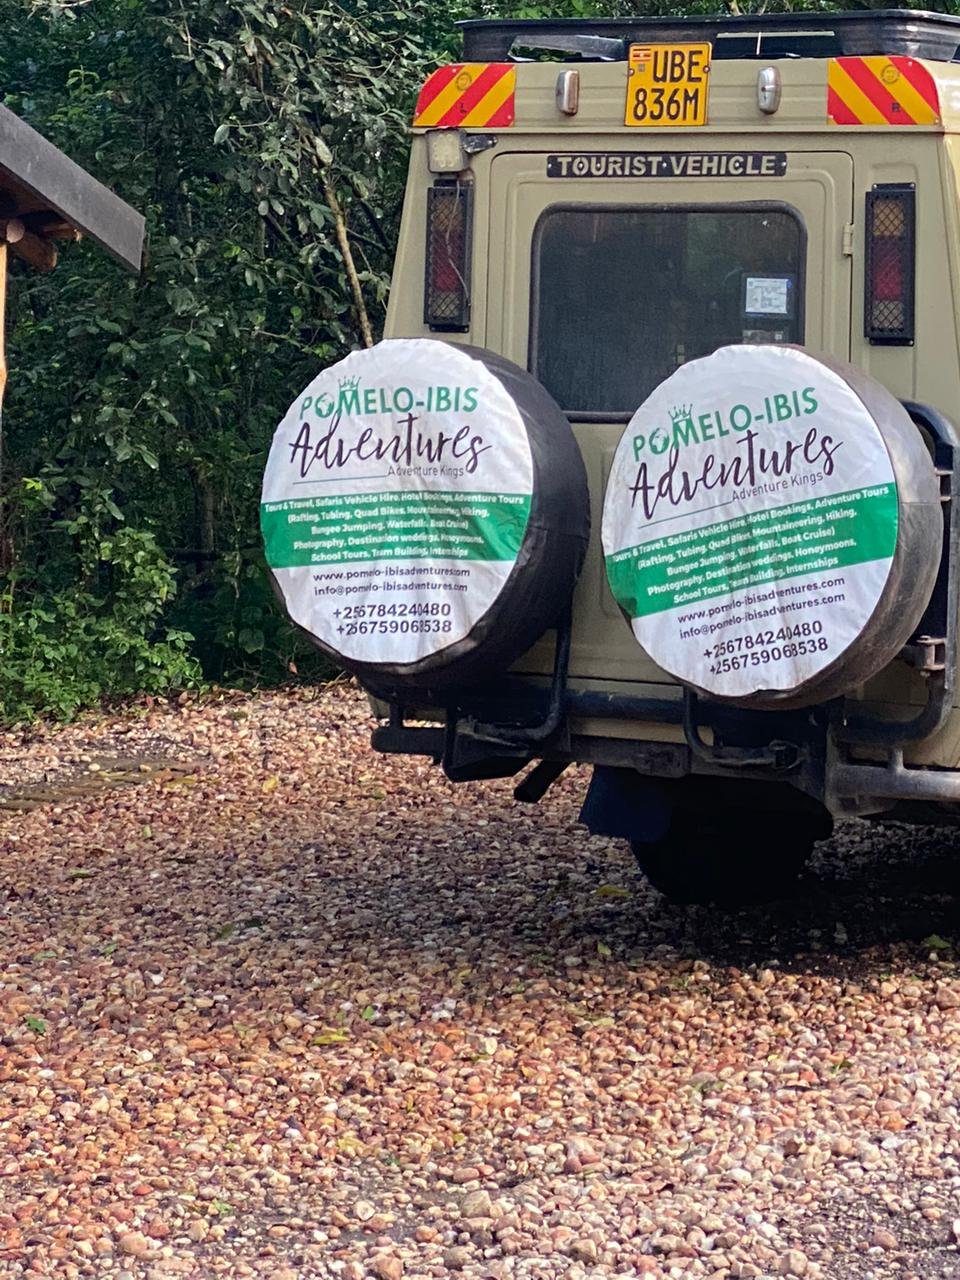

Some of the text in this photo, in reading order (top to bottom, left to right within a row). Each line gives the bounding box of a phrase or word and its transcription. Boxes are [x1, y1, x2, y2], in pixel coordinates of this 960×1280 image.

[653, 50, 703, 84] UBE
[633, 88, 700, 121] 836M
[557, 155, 776, 177] TOURIST VEHICLE
[300, 385, 479, 420] POMELO-IBIS
[633, 387, 819, 462] POMELO-IBIS
[289, 410, 493, 478] Adventures
[387, 465, 465, 479] Adventure Kings
[629, 427, 844, 520] Adventures
[731, 472, 824, 502] Adventure Kings
[344, 494, 378, 504] Vehicle
[498, 494, 525, 505] Tours
[354, 508, 379, 519] Quad
[815, 492, 861, 509] Adventure
[861, 486, 889, 499] Tours
[311, 551, 341, 562] School
[666, 562, 699, 576] Bungee
[782, 533, 802, 546] Boat
[803, 526, 836, 541] Cruise)
[708, 536, 730, 550] Quad
[673, 589, 701, 604] School
[786, 557, 839, 574] Internships
[332, 603, 451, 619] +256784240480
[703, 620, 823, 659] +256784240480
[709, 637, 829, 675] +256759068538
